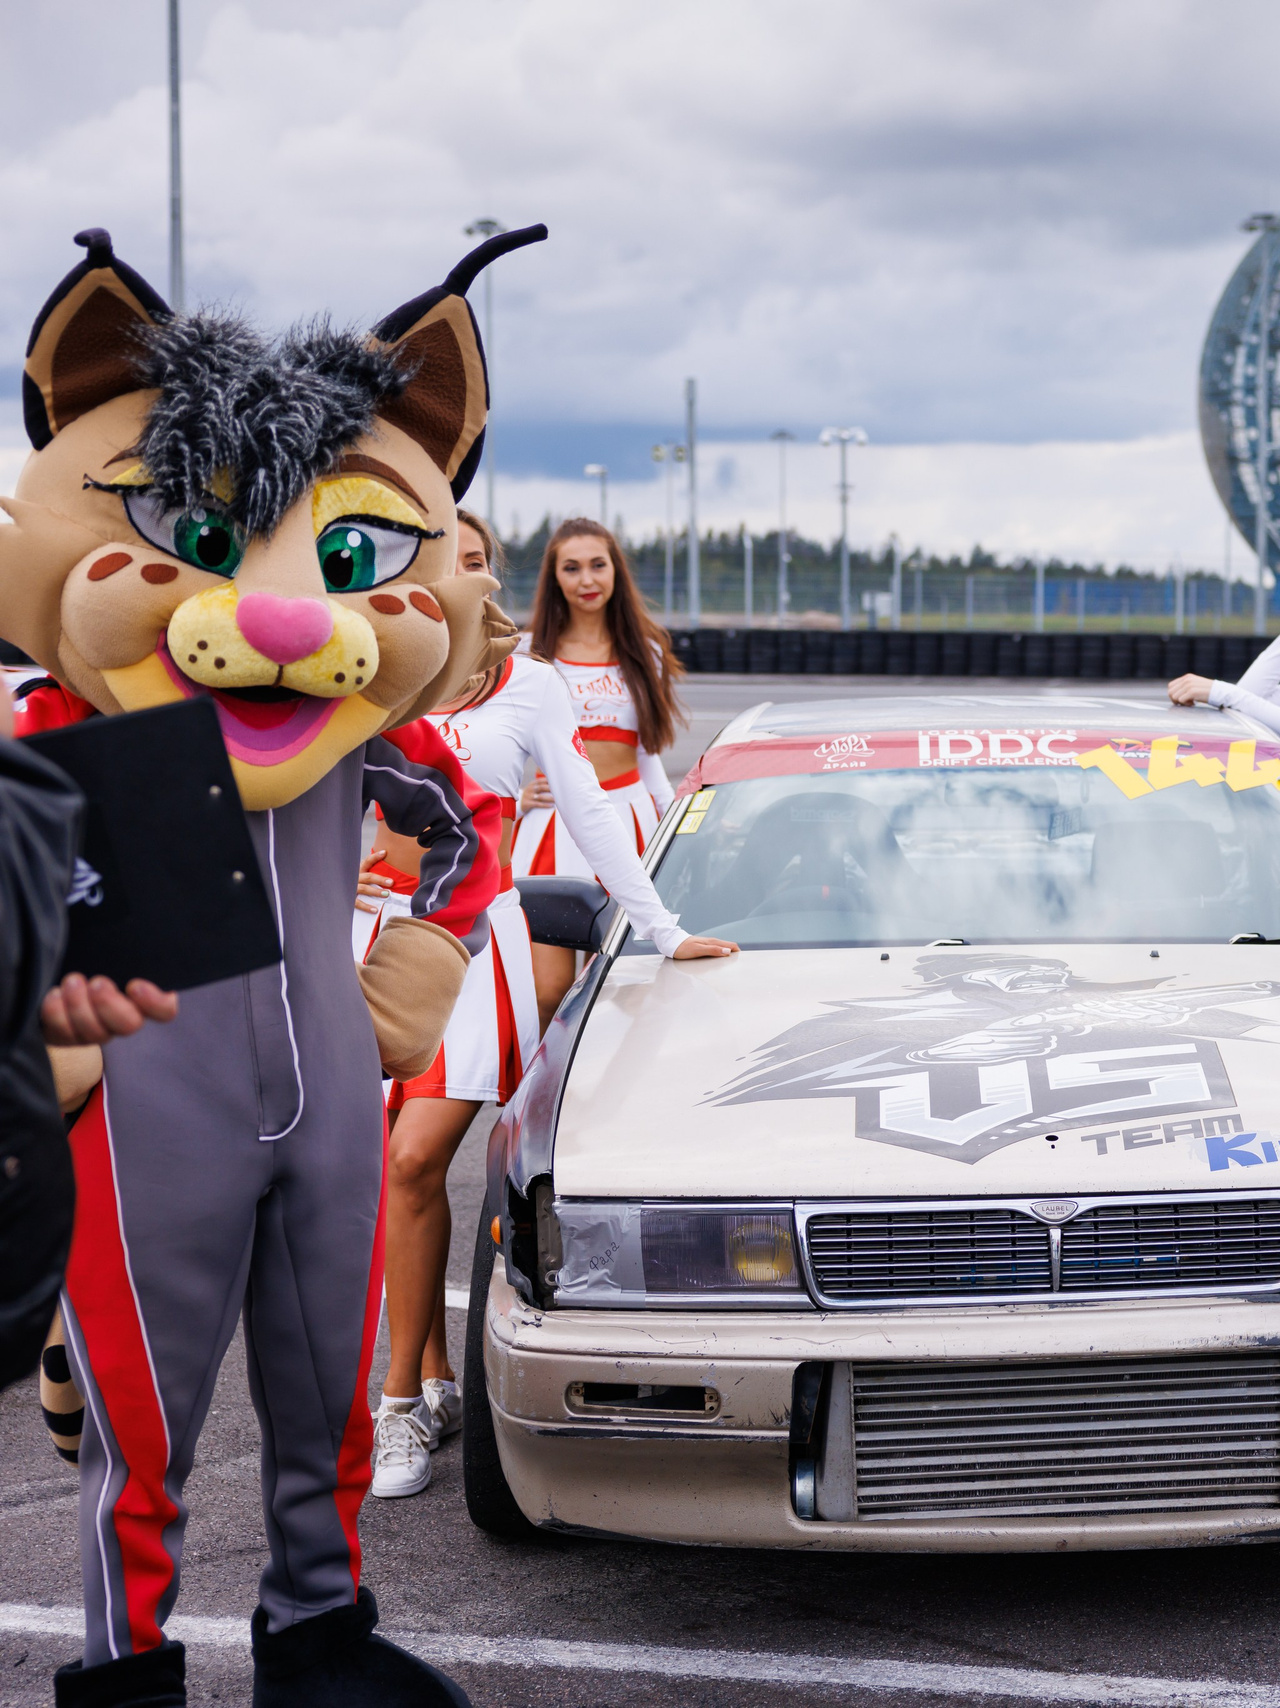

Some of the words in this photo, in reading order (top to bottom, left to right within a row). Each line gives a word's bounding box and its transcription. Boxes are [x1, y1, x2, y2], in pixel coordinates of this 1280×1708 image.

[918, 733, 1080, 760] IDDC
[822, 761, 867, 770] ДРАЙВ
[919, 758, 972, 767] DRIFT
[1080, 1113, 1245, 1156] TEAM
